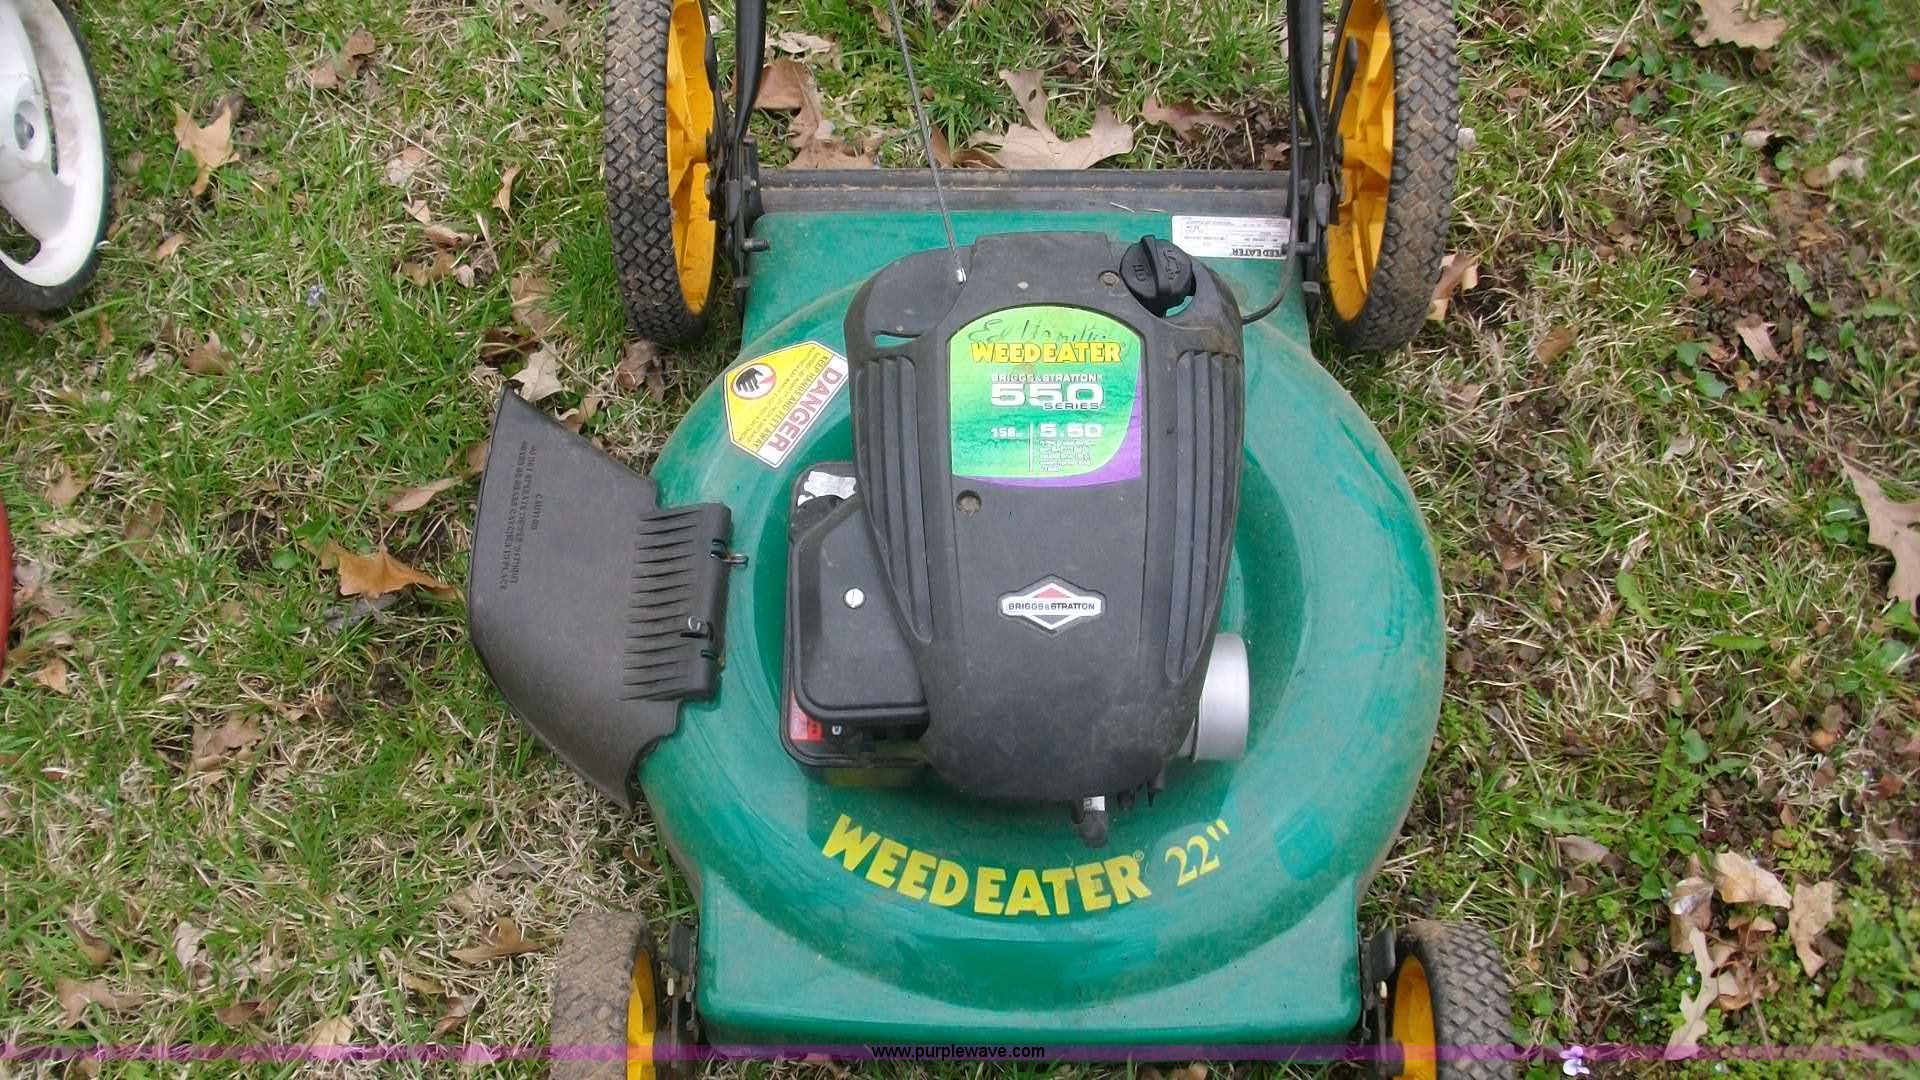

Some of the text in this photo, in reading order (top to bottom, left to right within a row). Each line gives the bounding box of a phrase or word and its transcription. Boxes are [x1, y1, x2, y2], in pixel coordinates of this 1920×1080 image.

[990, 383, 1104, 407] 550
[768, 367, 844, 452] DANGER
[1039, 423, 1103, 438] 5.50
[1008, 602, 1095, 610] BRIGGS&STRATTON
[1164, 818, 1230, 887] 22"
